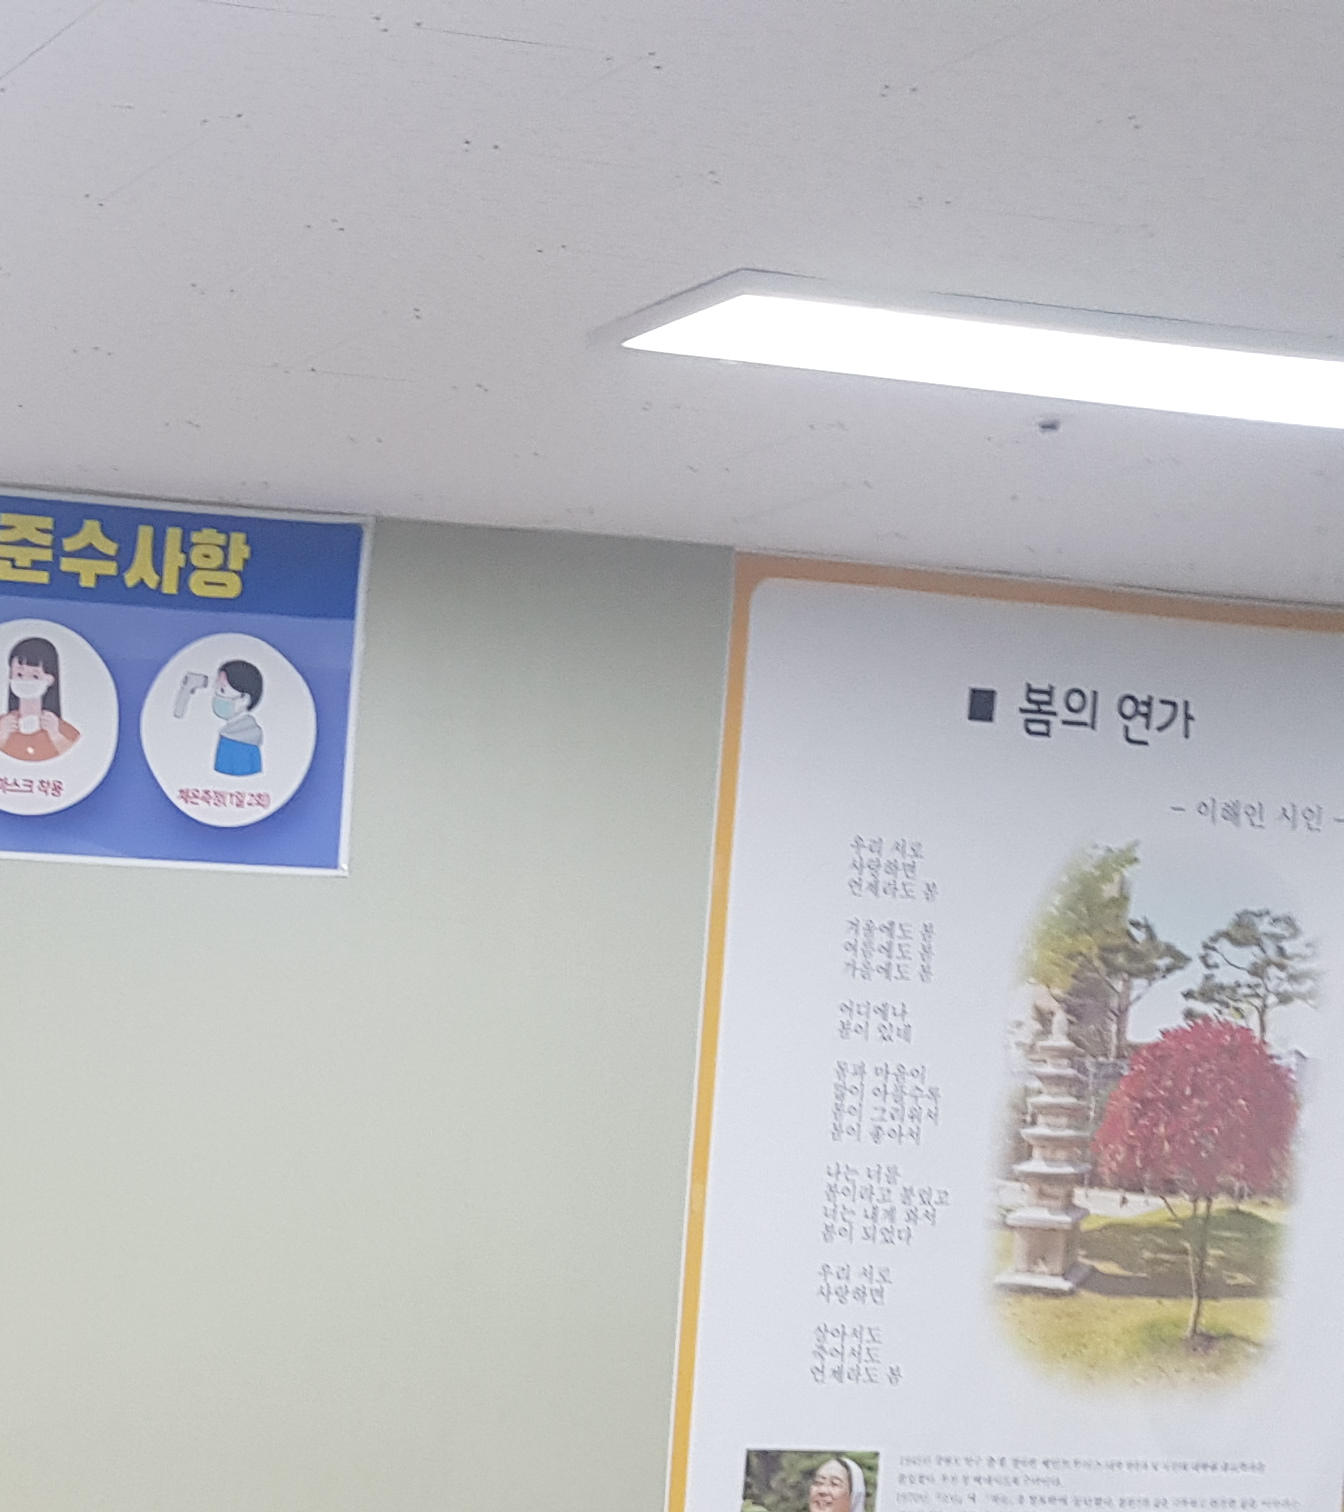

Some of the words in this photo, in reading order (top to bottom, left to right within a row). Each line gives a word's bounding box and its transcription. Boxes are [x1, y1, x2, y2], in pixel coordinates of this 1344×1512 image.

[1018, 681, 1099, 738] 봄의
[1116, 693, 1196, 746] 연가
[37, 778, 64, 797] 착용
[1196, 797, 1265, 829] 이해인
[1279, 801, 1324, 832] 시인
[839, 999, 908, 1021] 어디에나
[826, 1161, 860, 1182] 나는
[861, 1223, 912, 1246] 되었다
[813, 1322, 883, 1345] 살아서도
